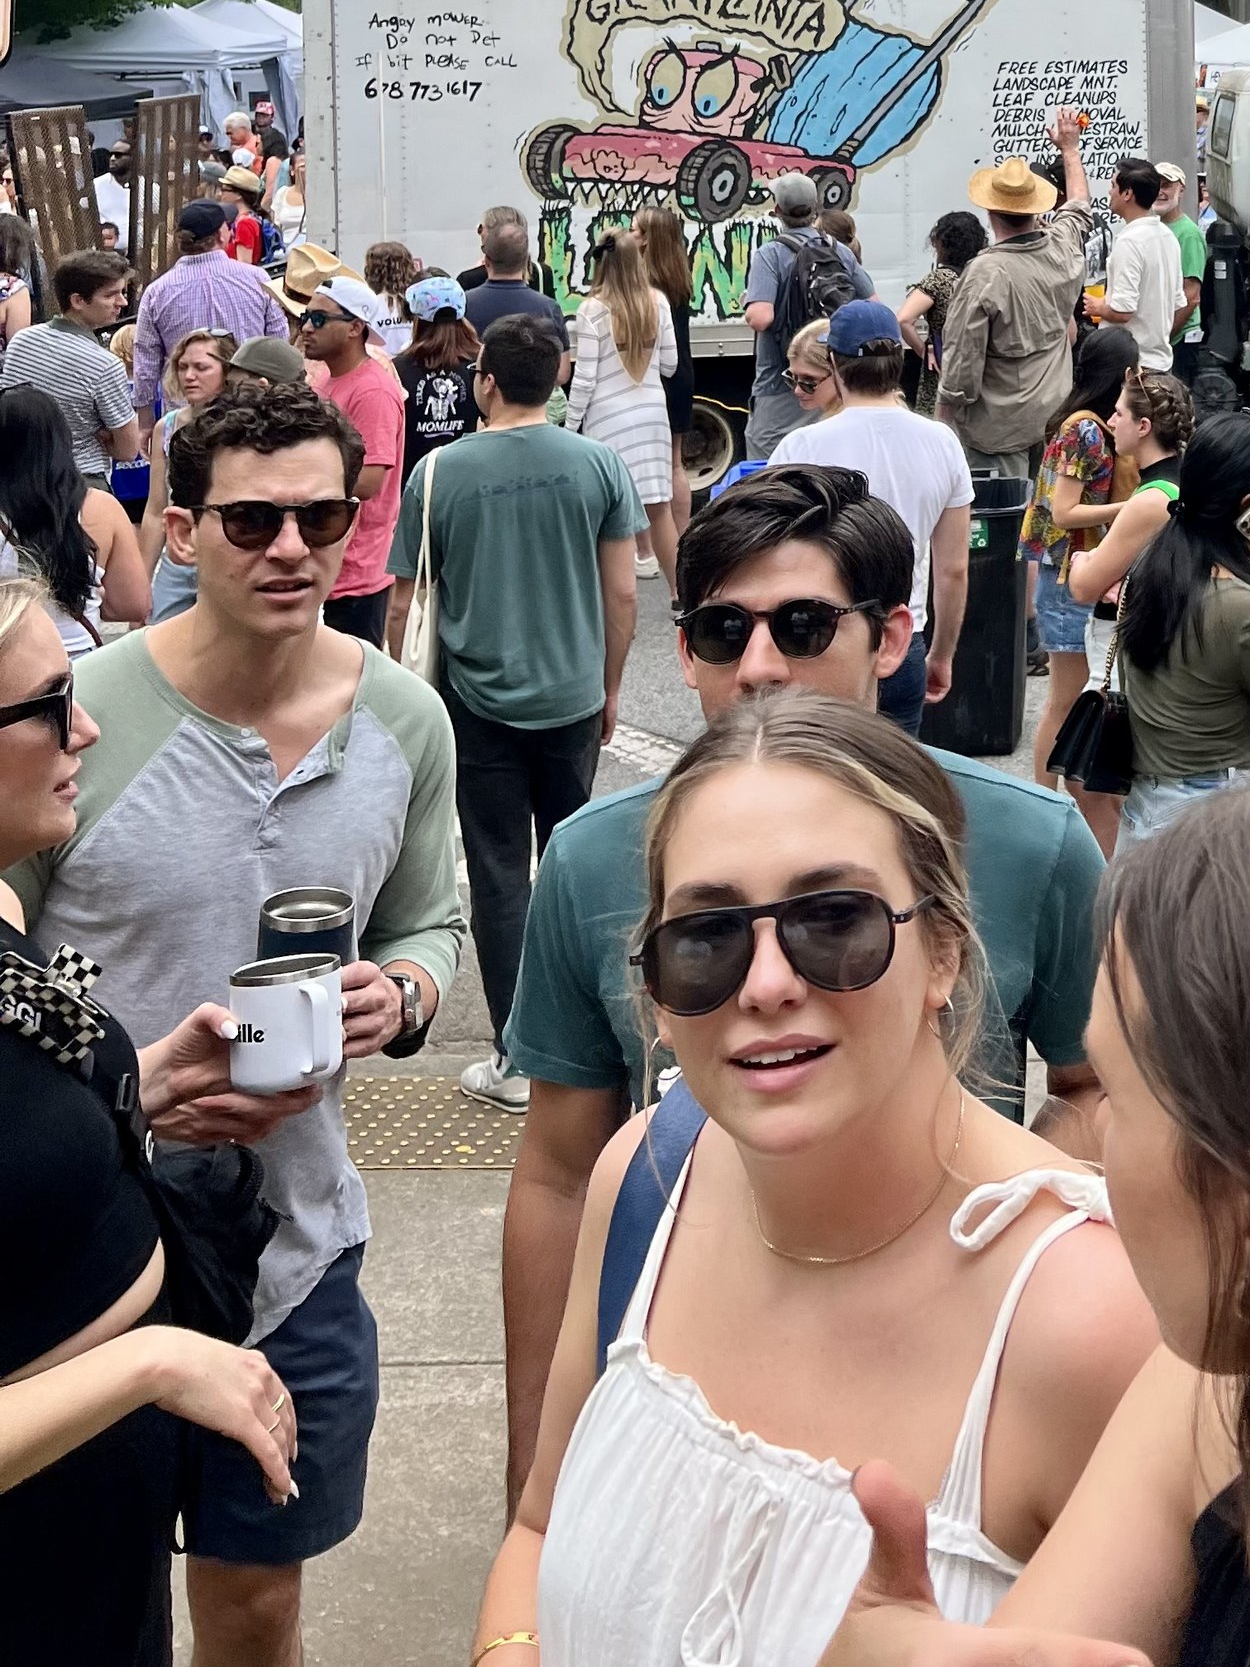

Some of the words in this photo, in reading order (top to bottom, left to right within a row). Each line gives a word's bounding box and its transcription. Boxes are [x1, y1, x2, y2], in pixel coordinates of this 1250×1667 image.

[386, 33, 408, 50] Do
[387, 54, 413, 70] bit
[484, 53, 518, 68] CALL
[996, 60, 1039, 75] FREE
[1044, 59, 1129, 75] ESTIMATES
[364, 77, 404, 99] 678
[409, 81, 443, 102] 773
[446, 79, 483, 102] 1617
[992, 76, 1076, 91] LANDSCAPE
[1080, 75, 1119, 90] MNT.
[992, 91, 1035, 107] LEAF
[1044, 90, 1117, 106] CLEANUPS
[993, 108, 1046, 123] DEBRIS
[1075, 106, 1126, 121] MOVAL
[1093, 136, 1144, 151] SERVICE
[416, 419, 465, 433] MOMLIFE
